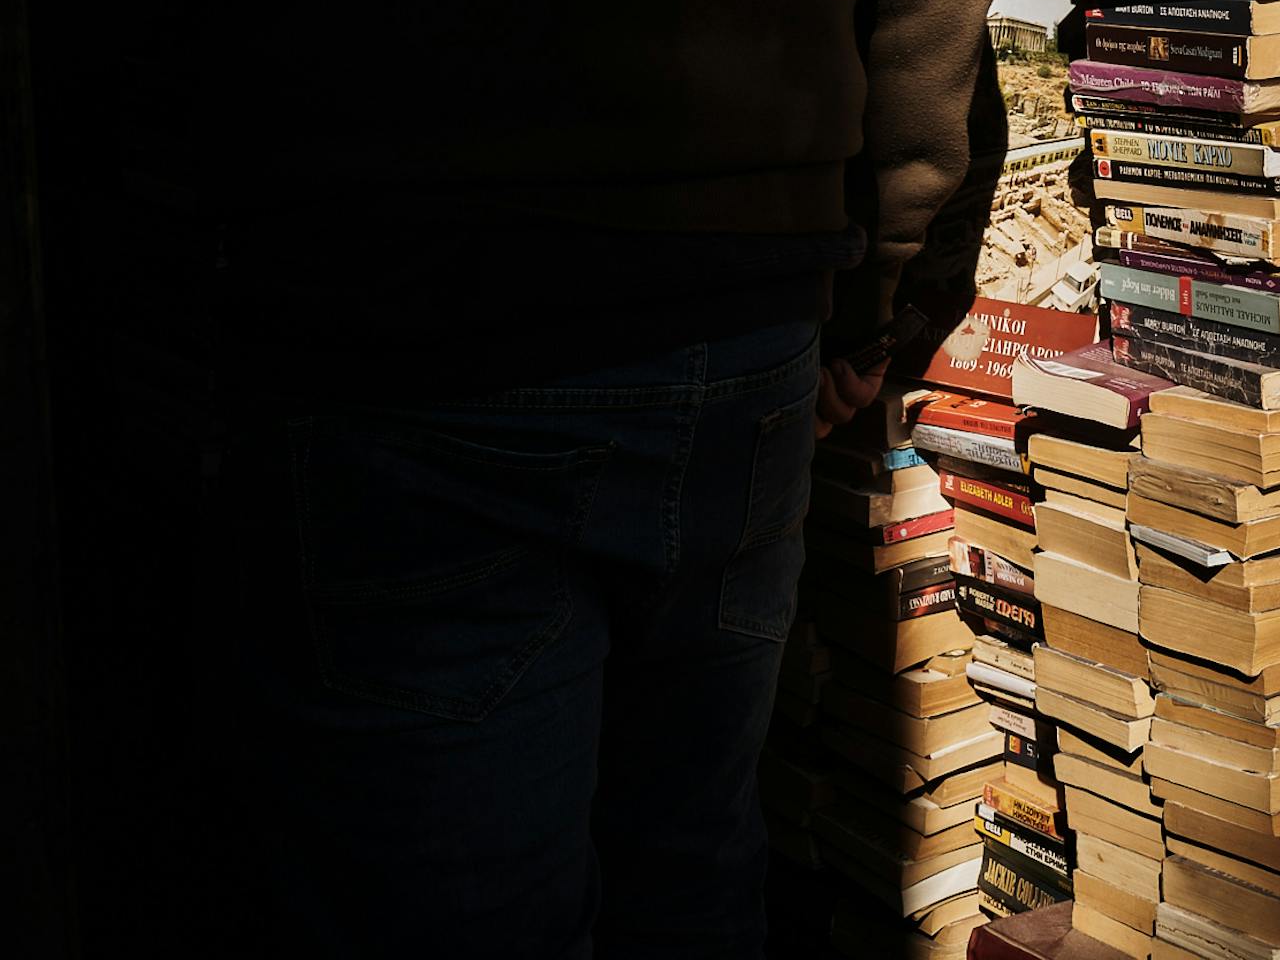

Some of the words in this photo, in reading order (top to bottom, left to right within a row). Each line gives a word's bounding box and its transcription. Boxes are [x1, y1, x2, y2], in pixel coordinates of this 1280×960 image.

[1114, 137, 1140, 147] STEPHEN
[1112, 145, 1142, 155] SHEPPARD
[1114, 208, 1133, 221] BELL
[1145, 212, 1182, 232] ΠΟΛΕΜΟΣ
[960, 480, 993, 500] ELIZABETH
[993, 492, 1013, 508] ADLER
[985, 821, 1001, 836] BELL
[984, 858, 1017, 897] JACKIE
